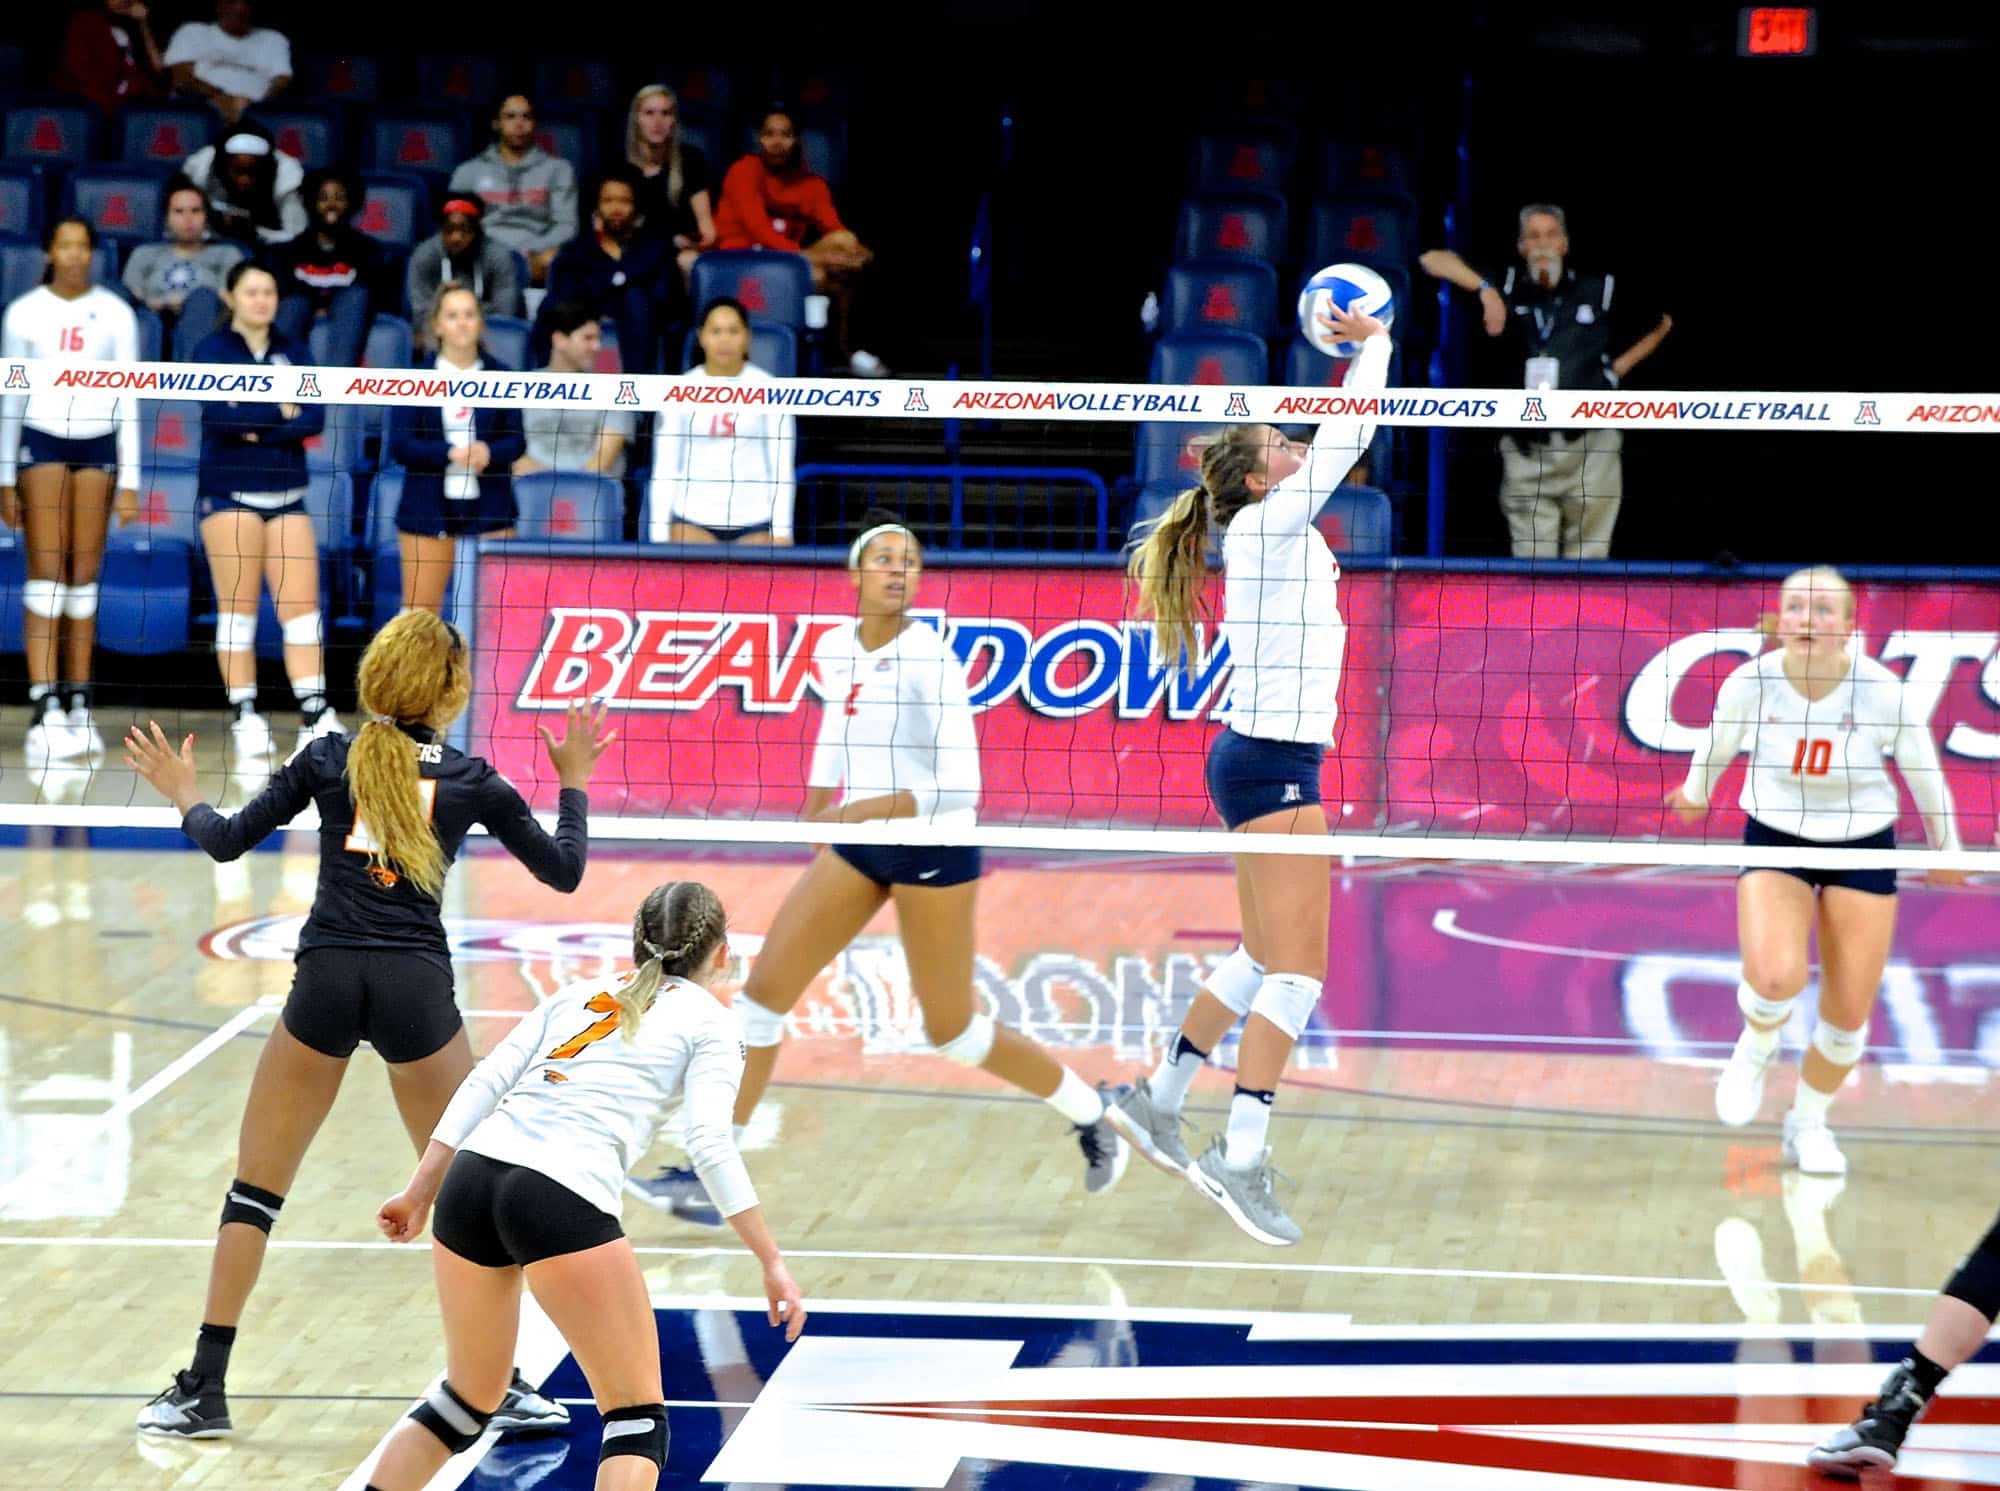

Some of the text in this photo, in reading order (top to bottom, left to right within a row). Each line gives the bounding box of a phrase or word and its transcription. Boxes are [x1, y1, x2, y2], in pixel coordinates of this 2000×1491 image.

[59, 326, 85, 352] 16
[5, 365, 30, 389] A
[296, 373, 321, 397] A
[614, 380, 640, 405] A
[904, 387, 929, 411] A
[1224, 392, 1250, 416] A
[1520, 397, 1547, 421] A
[1854, 401, 1881, 425] A
[946, 615, 1236, 719] DOW
[1624, 627, 2000, 759] CT
[1791, 738, 1832, 776] 10
